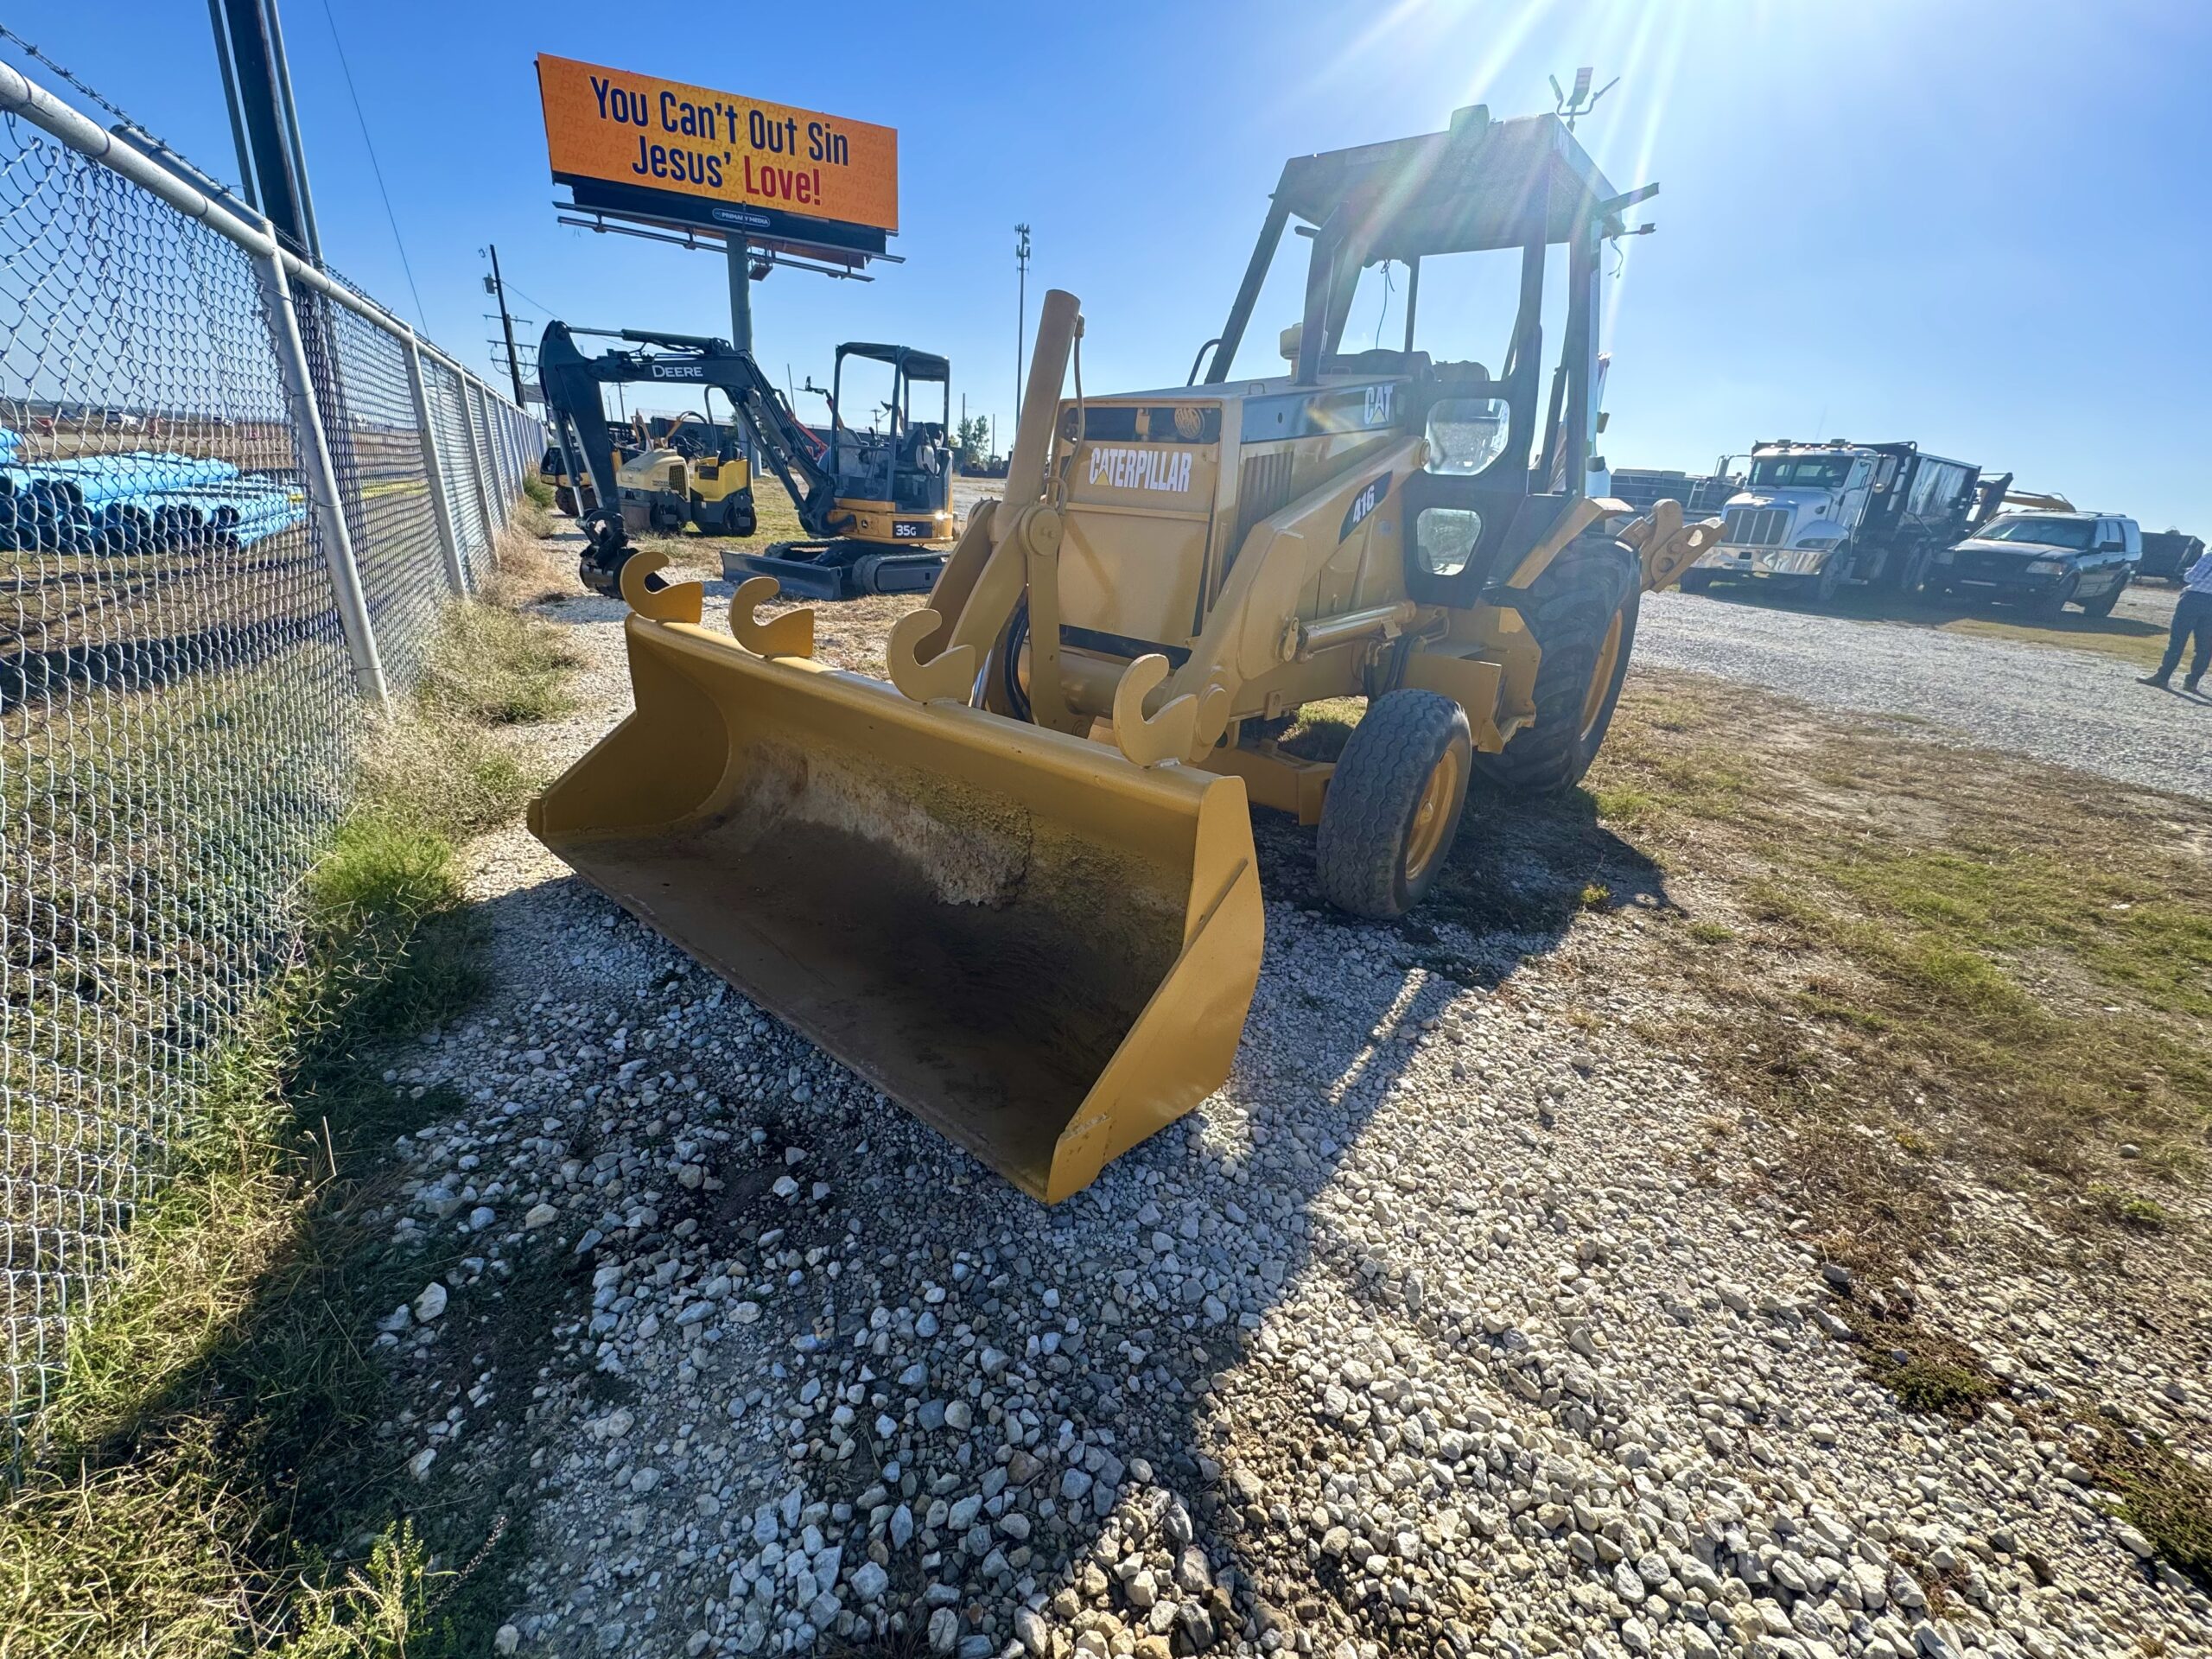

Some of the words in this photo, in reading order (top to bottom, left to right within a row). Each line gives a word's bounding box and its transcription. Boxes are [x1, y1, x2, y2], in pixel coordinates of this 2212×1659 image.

[589, 76, 647, 127] You
[660, 91, 738, 144] Can't
[749, 110, 797, 156] Out
[808, 122, 849, 166] Sin
[632, 135, 731, 188] Jesus'
[744, 156, 821, 206] Love!
[750, 149, 790, 168] PRAY
[749, 216, 768, 225] MEDIA
[652, 365, 703, 378] DEERE
[1363, 385, 1394, 425] CAT
[1089, 447, 1192, 493] CATERPILLAR
[1352, 484, 1376, 524] 416
[895, 524, 917, 537] 35G
